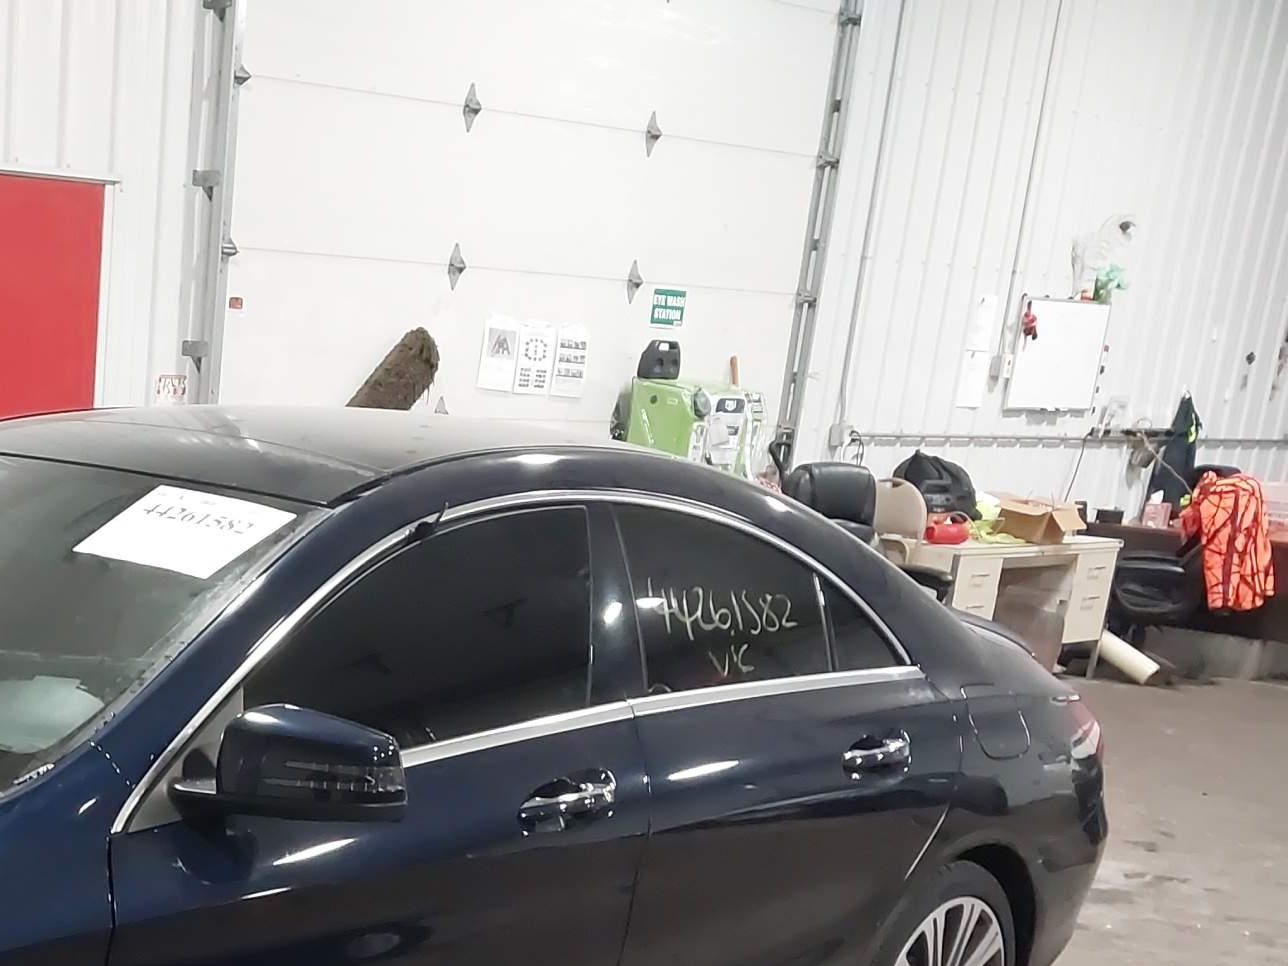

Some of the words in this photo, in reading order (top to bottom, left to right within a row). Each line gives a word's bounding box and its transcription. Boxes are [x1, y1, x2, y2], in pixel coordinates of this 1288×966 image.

[653, 294, 666, 305] EYE
[653, 308, 681, 320] STATION
[144, 503, 254, 534] 44261582
